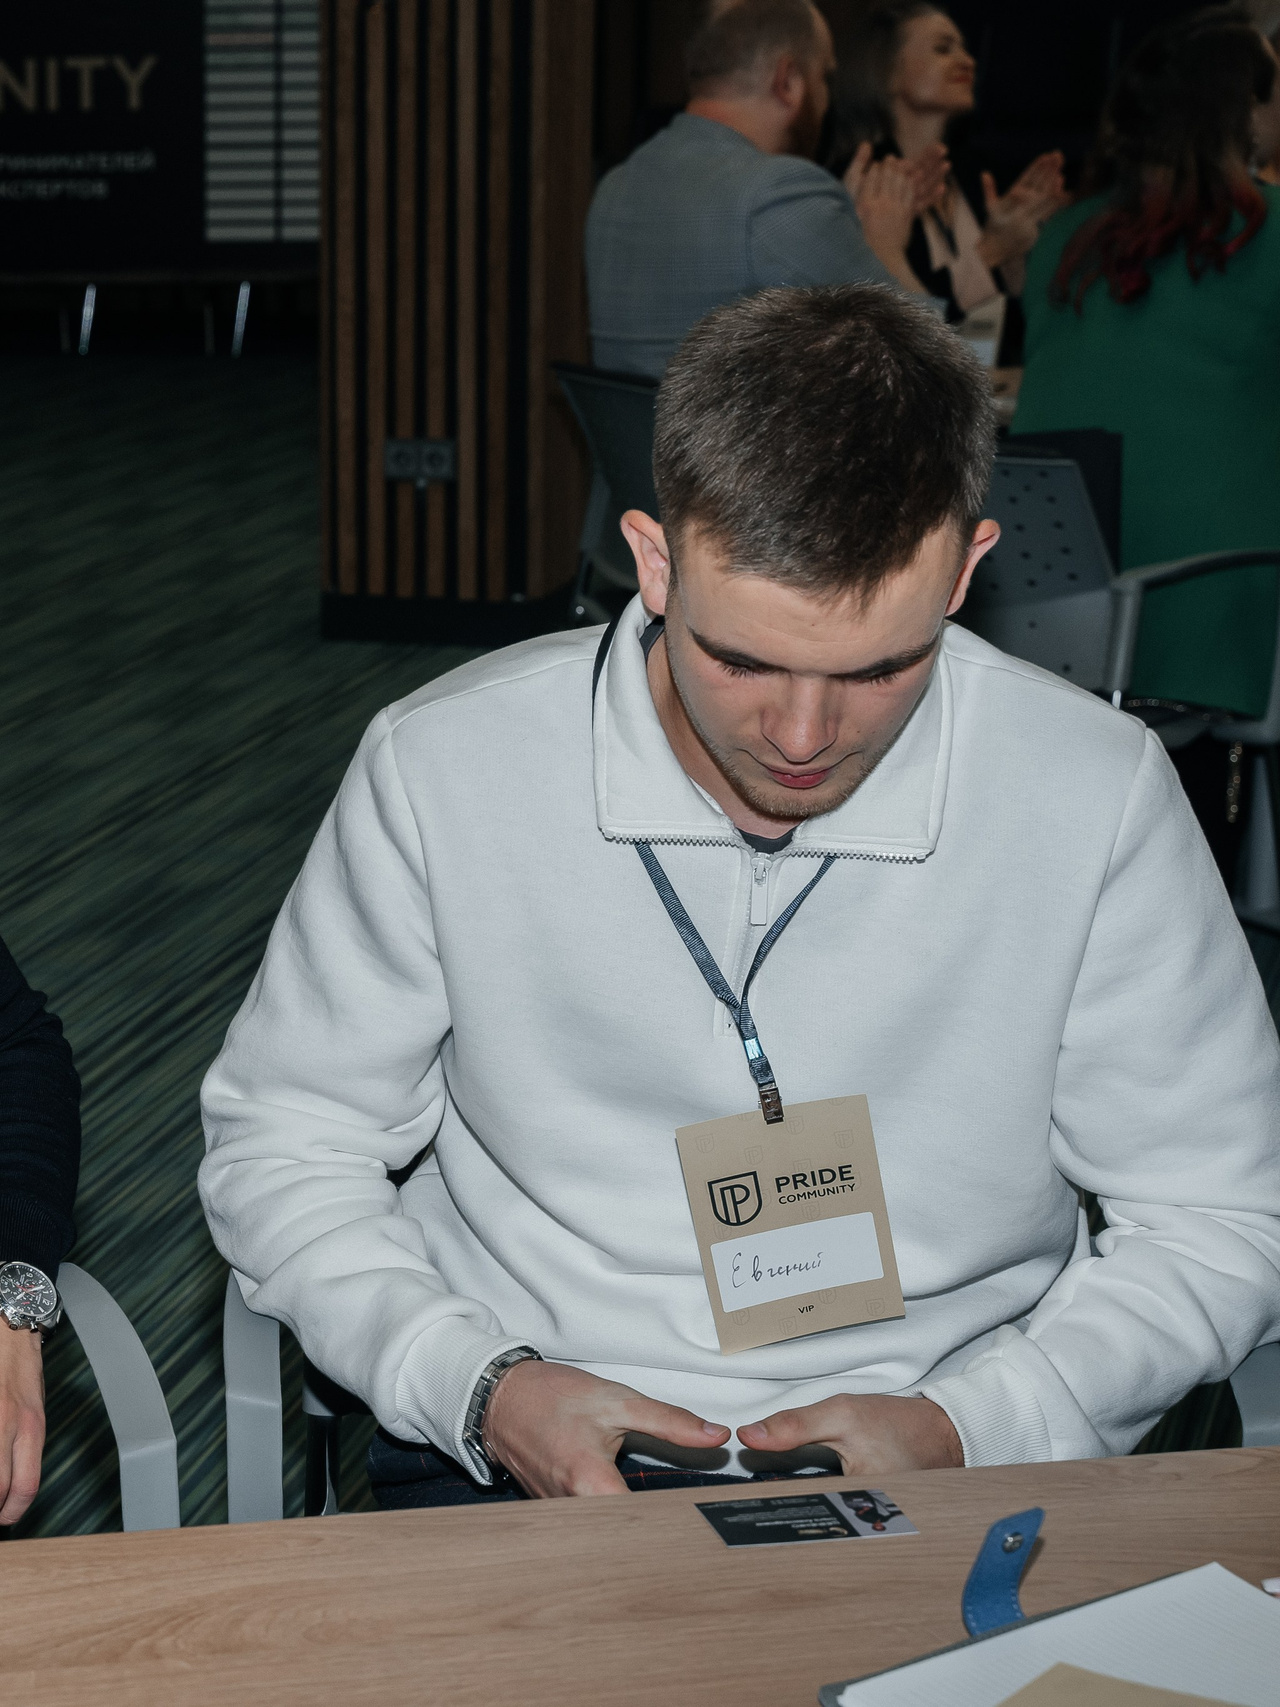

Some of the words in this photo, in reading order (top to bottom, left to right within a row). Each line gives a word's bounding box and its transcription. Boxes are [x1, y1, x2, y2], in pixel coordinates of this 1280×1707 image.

[775, 1164, 854, 1193] PRIDE
[778, 1183, 856, 1204] COMMUNITY
[731, 1251, 824, 1288] Евгений
[798, 1304, 815, 1314] VIP
